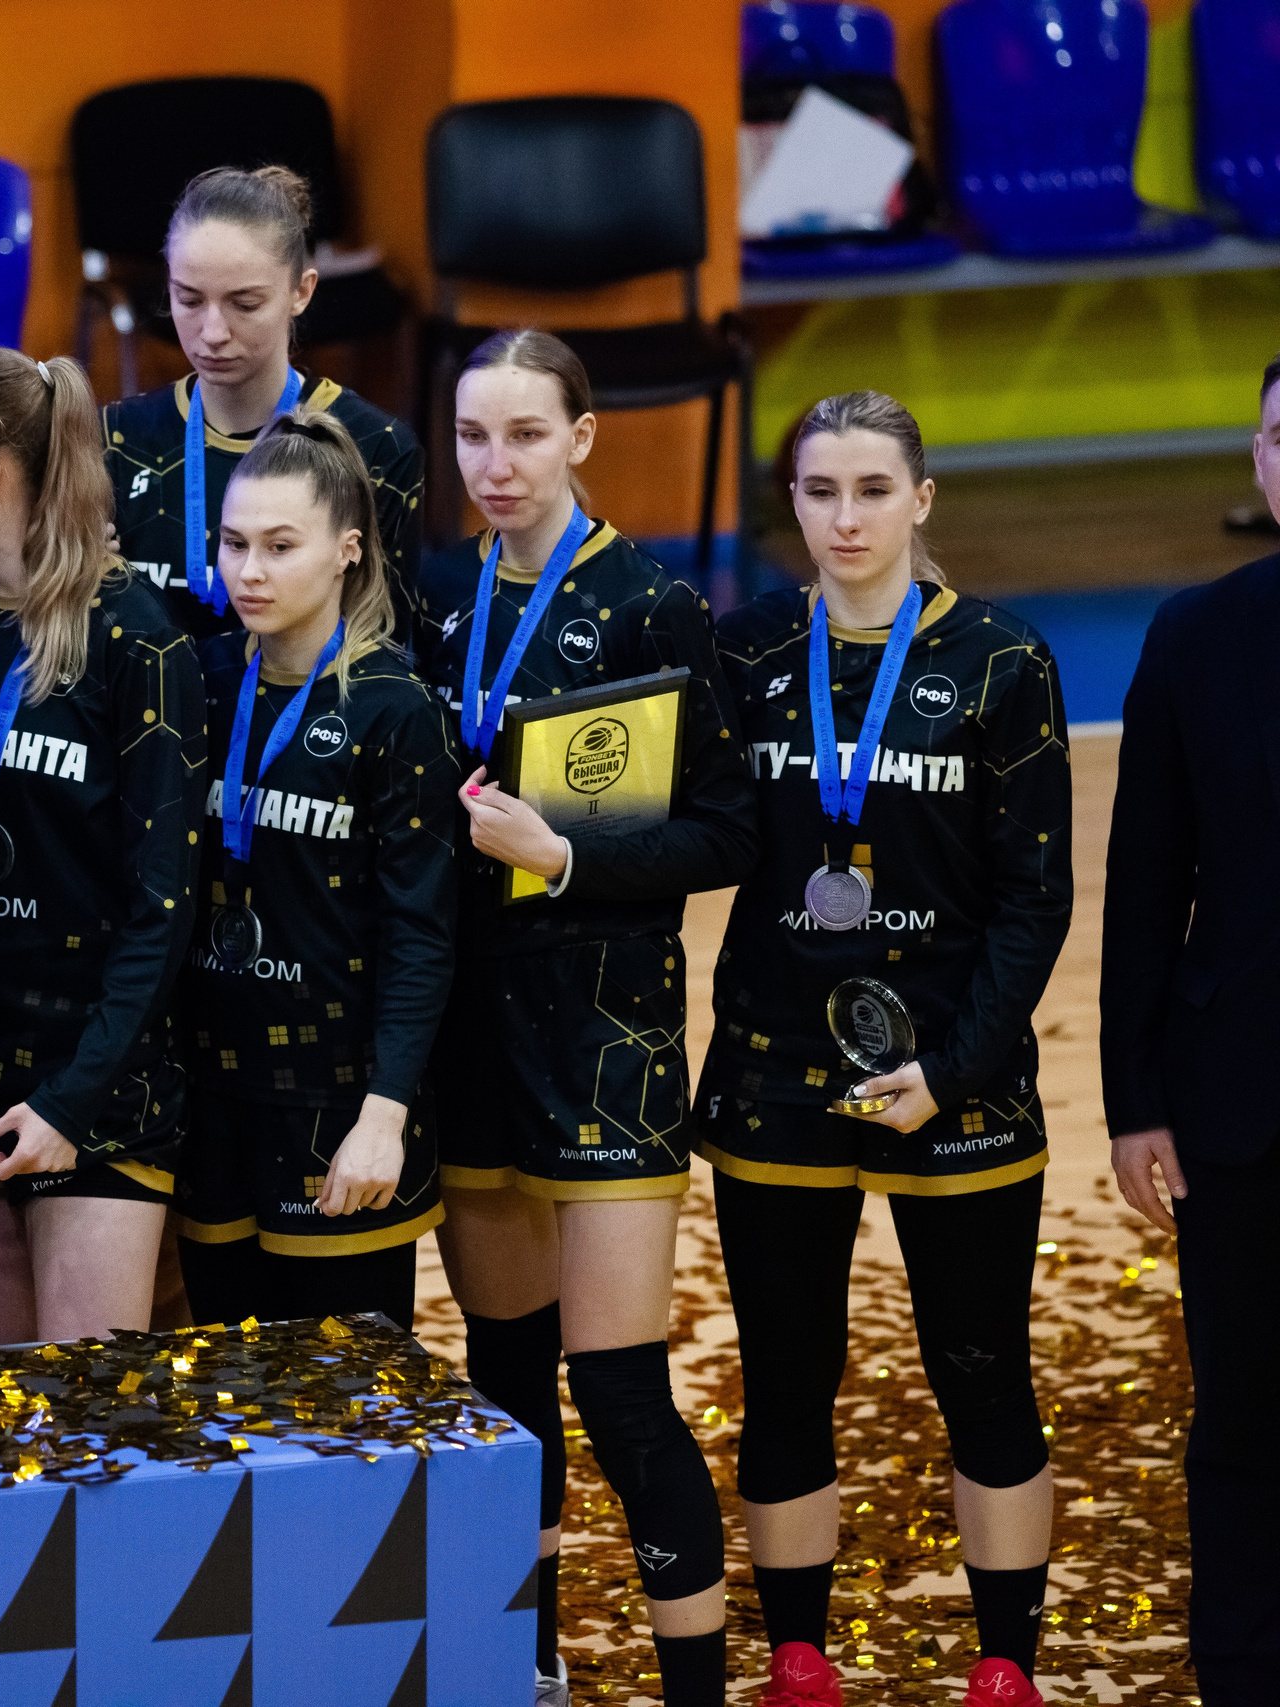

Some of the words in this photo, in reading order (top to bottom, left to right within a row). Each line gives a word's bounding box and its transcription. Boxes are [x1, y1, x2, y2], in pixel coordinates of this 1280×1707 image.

[563, 632, 593, 650] РФБ
[916, 687, 952, 704] РФБ
[310, 727, 341, 745] РФБ
[580, 751, 615, 764] FONBET
[573, 760, 619, 780] ВЫСШАЯ
[933, 1131, 1015, 1155] ХИМПРОМ
[559, 1147, 637, 1162] ХИМПРОМ
